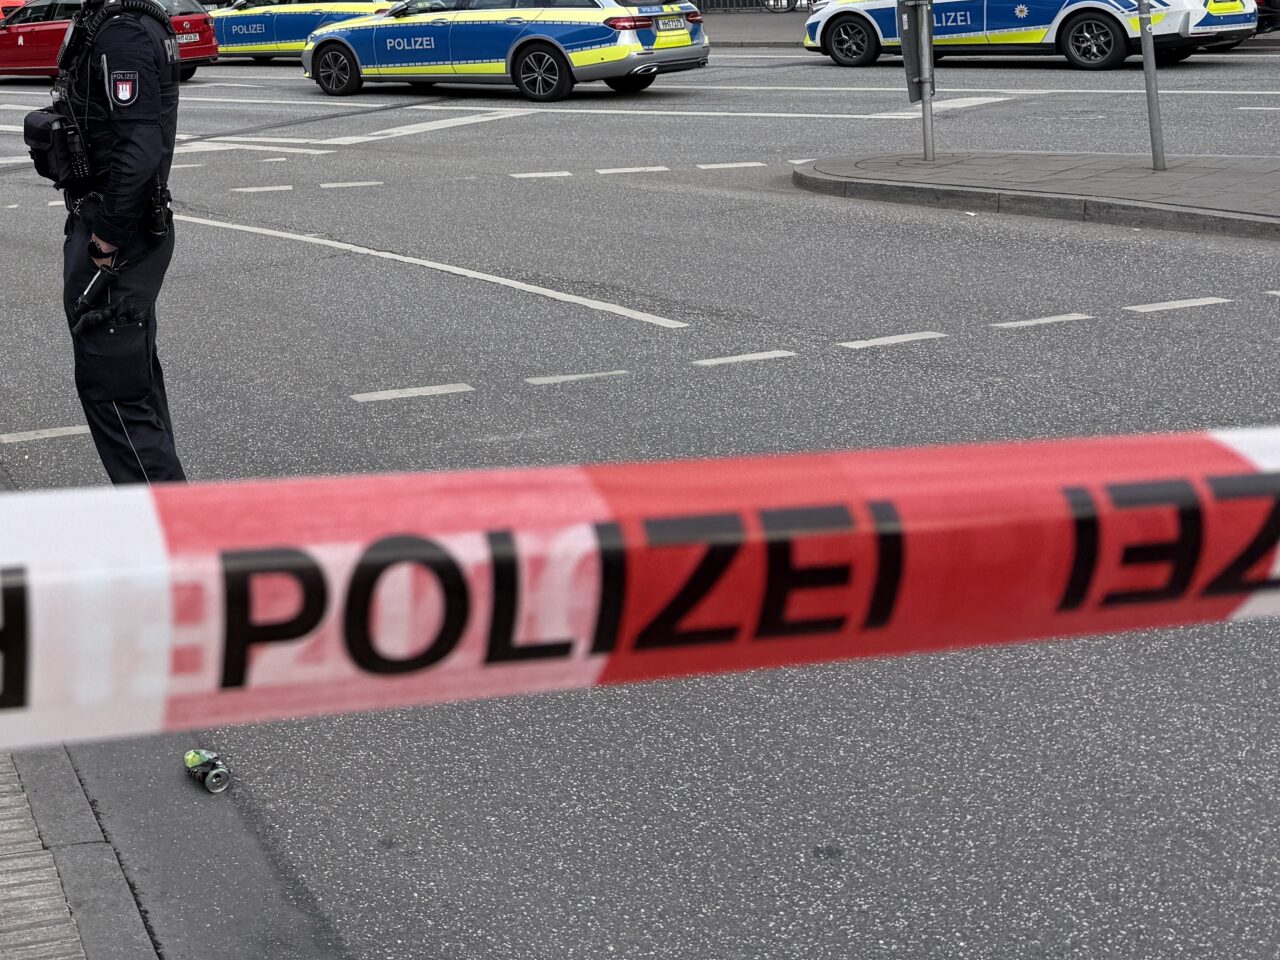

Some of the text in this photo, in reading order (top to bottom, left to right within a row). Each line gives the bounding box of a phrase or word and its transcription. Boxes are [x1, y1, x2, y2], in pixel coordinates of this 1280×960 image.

[933, 11, 971, 27] LIZEI
[231, 23, 266, 34] POLIZEI
[386, 37, 435, 50] POLIZEI
[218, 499, 906, 690] POLIZEI
